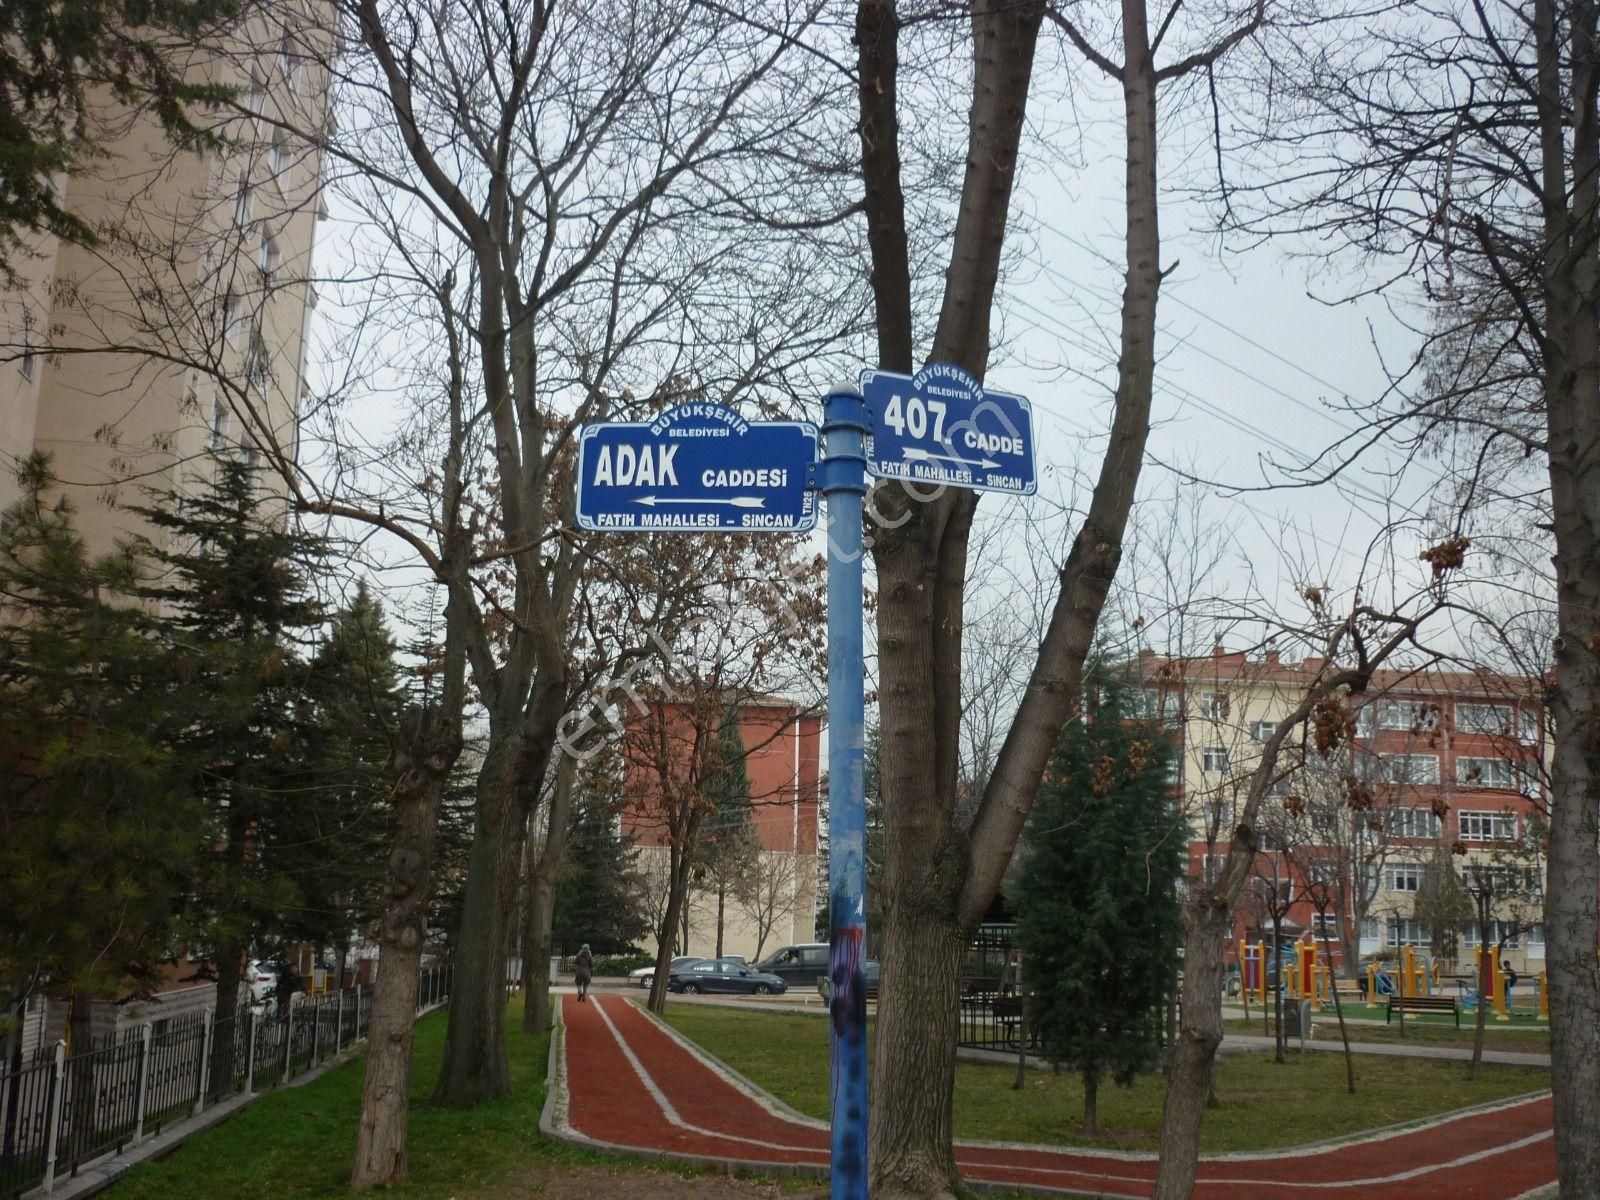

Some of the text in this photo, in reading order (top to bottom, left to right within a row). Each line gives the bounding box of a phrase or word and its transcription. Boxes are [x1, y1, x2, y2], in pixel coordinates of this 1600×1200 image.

[913, 364, 984, 402] BÜYÜKŞEHİR
[927, 385, 971, 400] BELEDİYESİ
[651, 405, 749, 437] BÜYÜKŞEHİR
[669, 426, 730, 437] BELEDİYESİ
[884, 394, 1024, 456] 407. CADDE
[593, 443, 680, 487] ADAK
[803, 491, 813, 515] TN26
